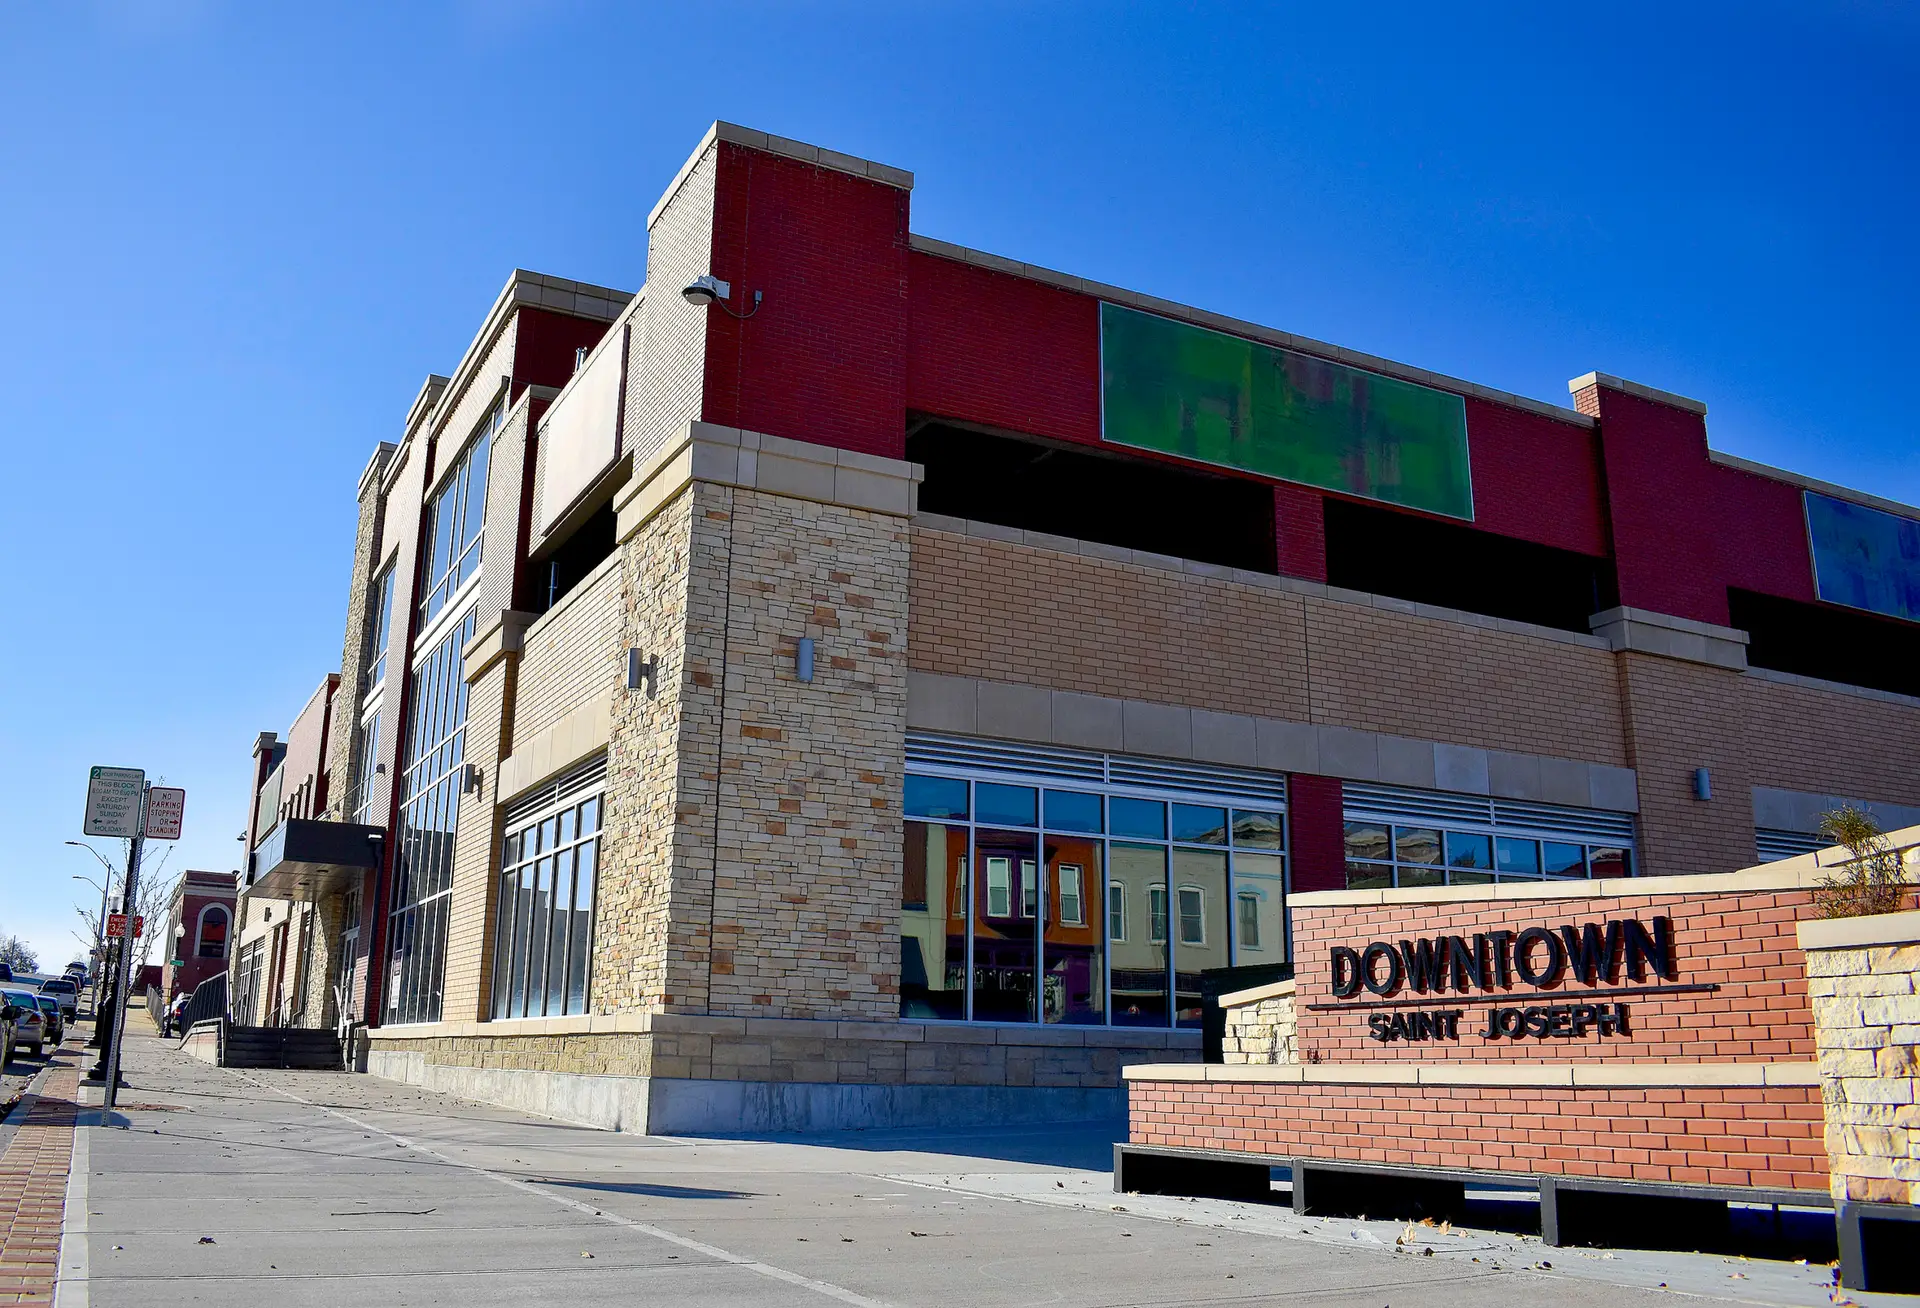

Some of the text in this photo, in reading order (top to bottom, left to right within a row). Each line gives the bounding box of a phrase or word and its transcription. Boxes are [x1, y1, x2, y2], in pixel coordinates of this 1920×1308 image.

[93, 768, 100, 779] 2
[114, 781, 136, 789] BLOCK
[96, 803, 131, 811] SATURDAY
[151, 801, 181, 809] PARKING
[151, 809, 180, 818] STOPPING
[94, 826, 128, 834] HOLIDAYS
[148, 826, 178, 835] STANDING
[1331, 916, 1674, 998] DOWNTOWN
[1368, 1003, 1629, 1041] SAINT JOSEPH
